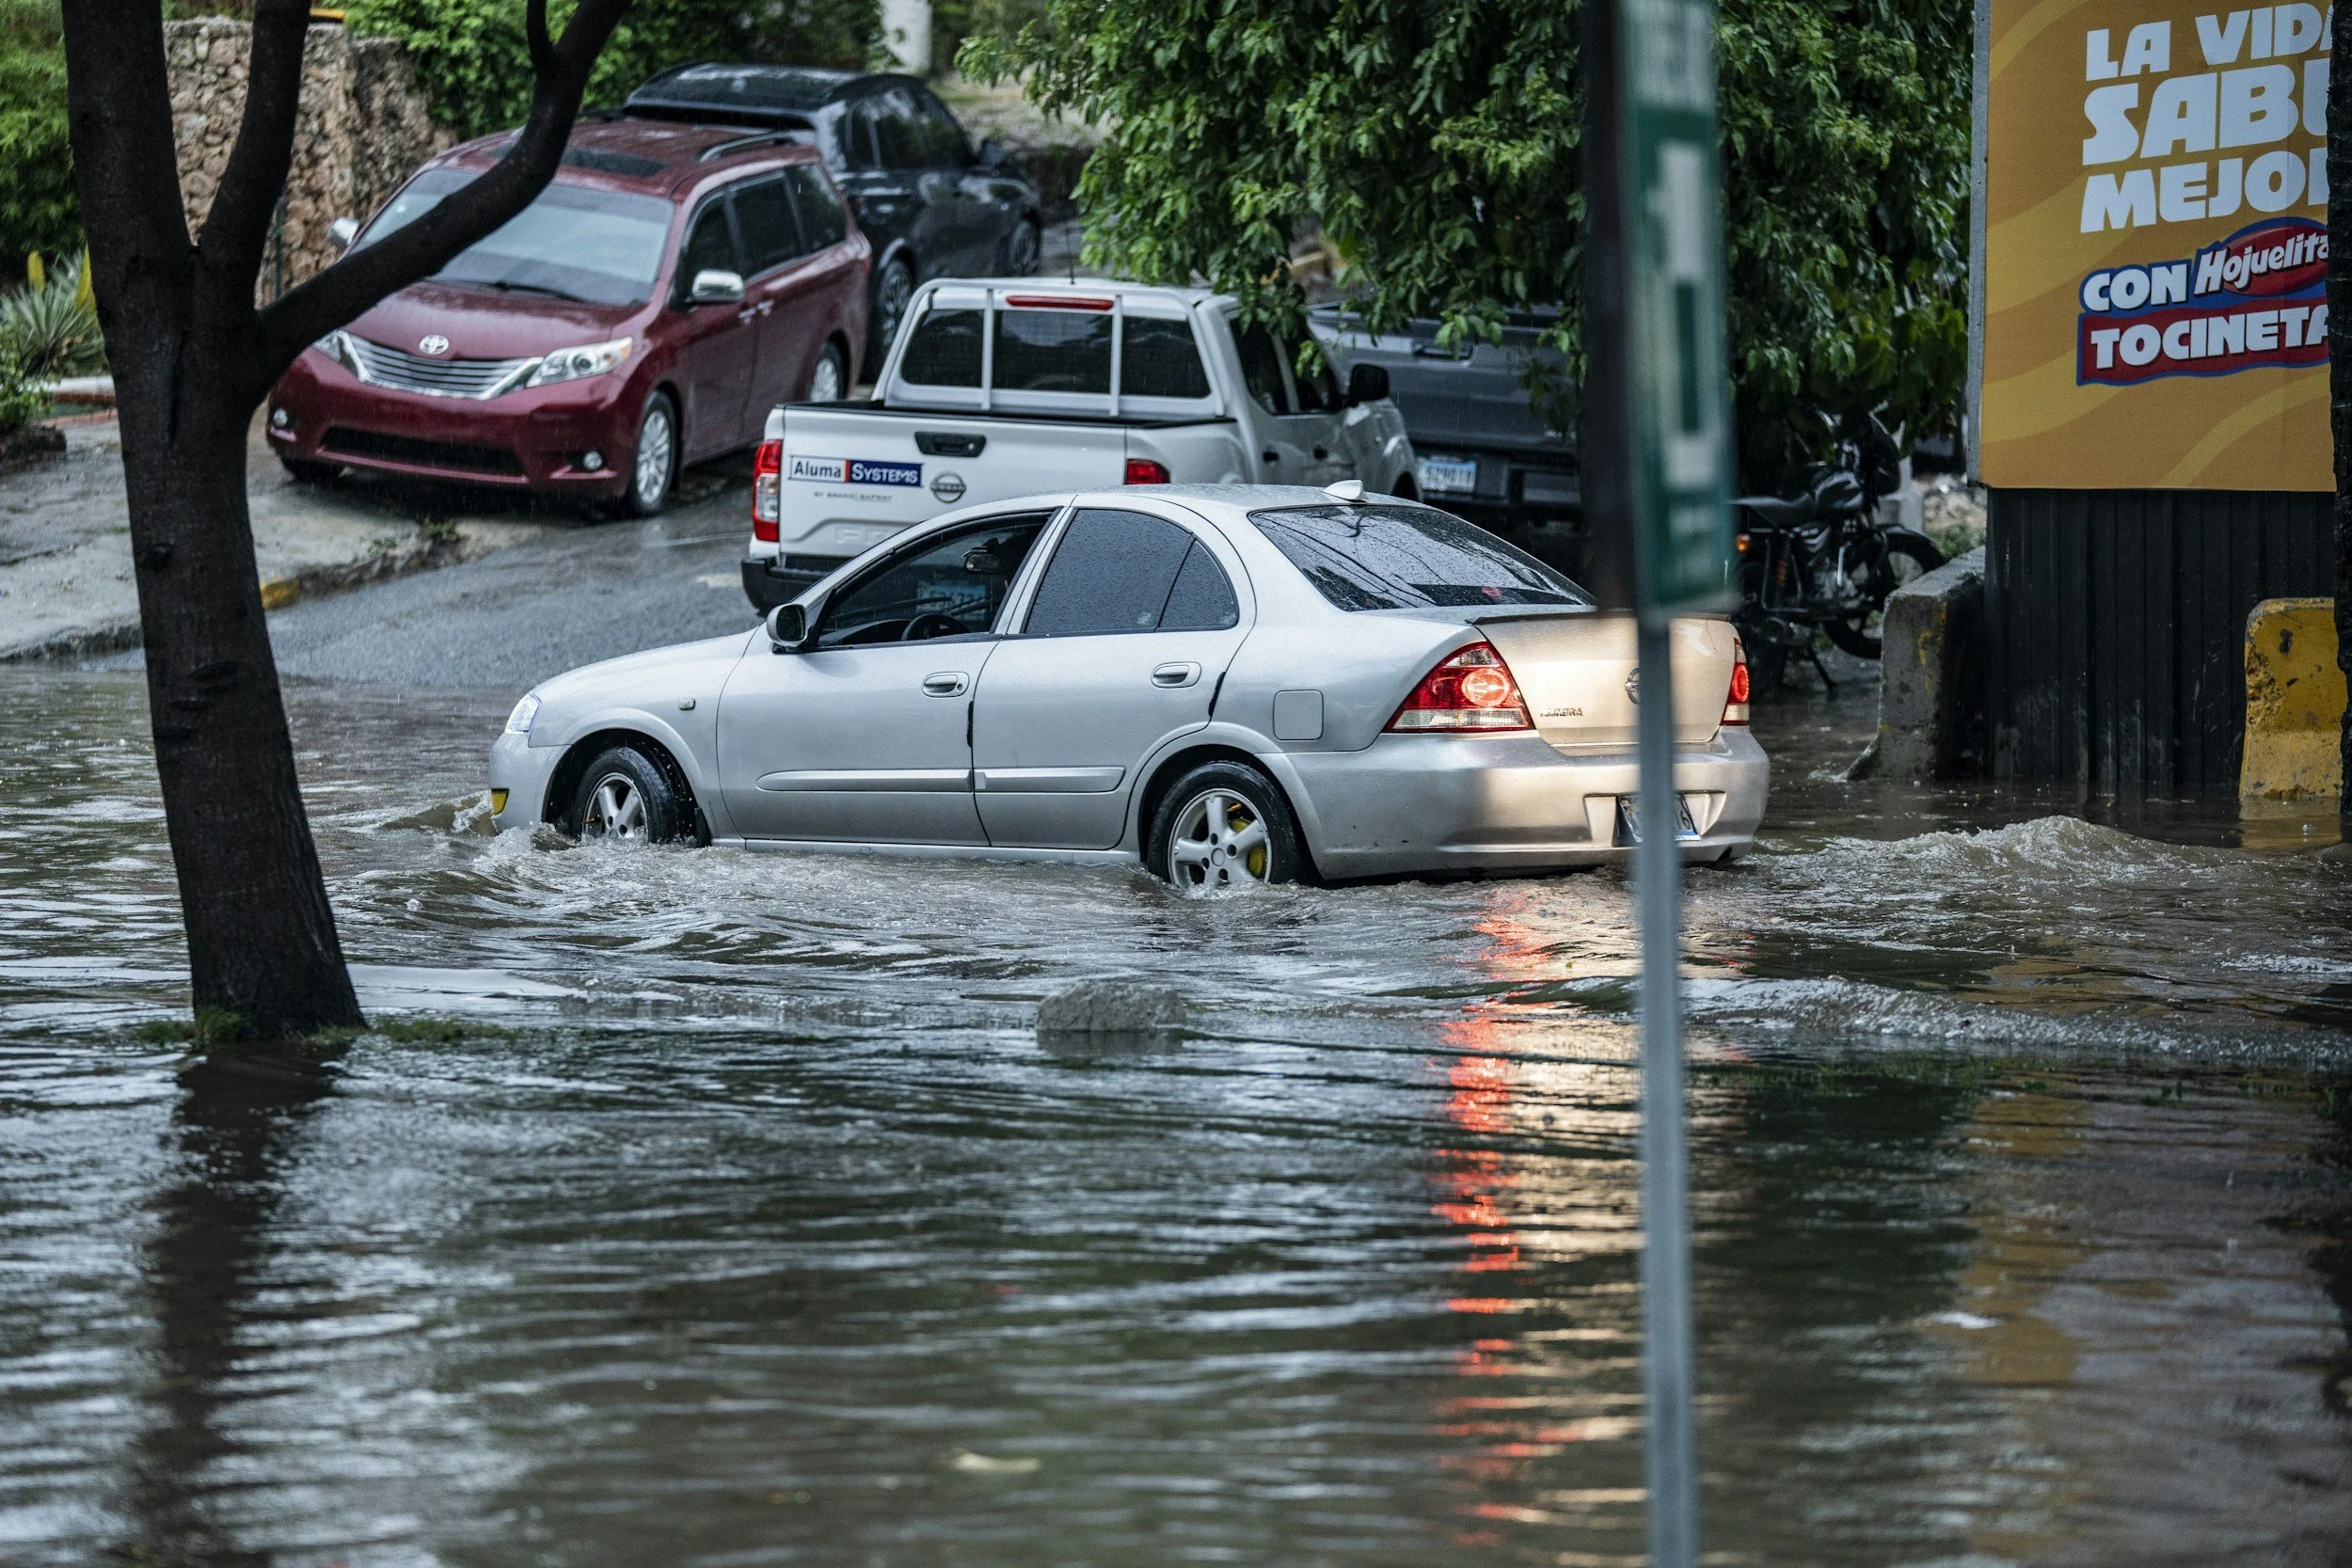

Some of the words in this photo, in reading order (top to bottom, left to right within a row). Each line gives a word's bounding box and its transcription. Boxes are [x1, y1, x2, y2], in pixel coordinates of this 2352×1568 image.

[2086, 20, 2170, 82] LA
[2195, 3, 2332, 66] VID
[2083, 263, 2187, 311] CON
[794, 461, 842, 479] Aluma
